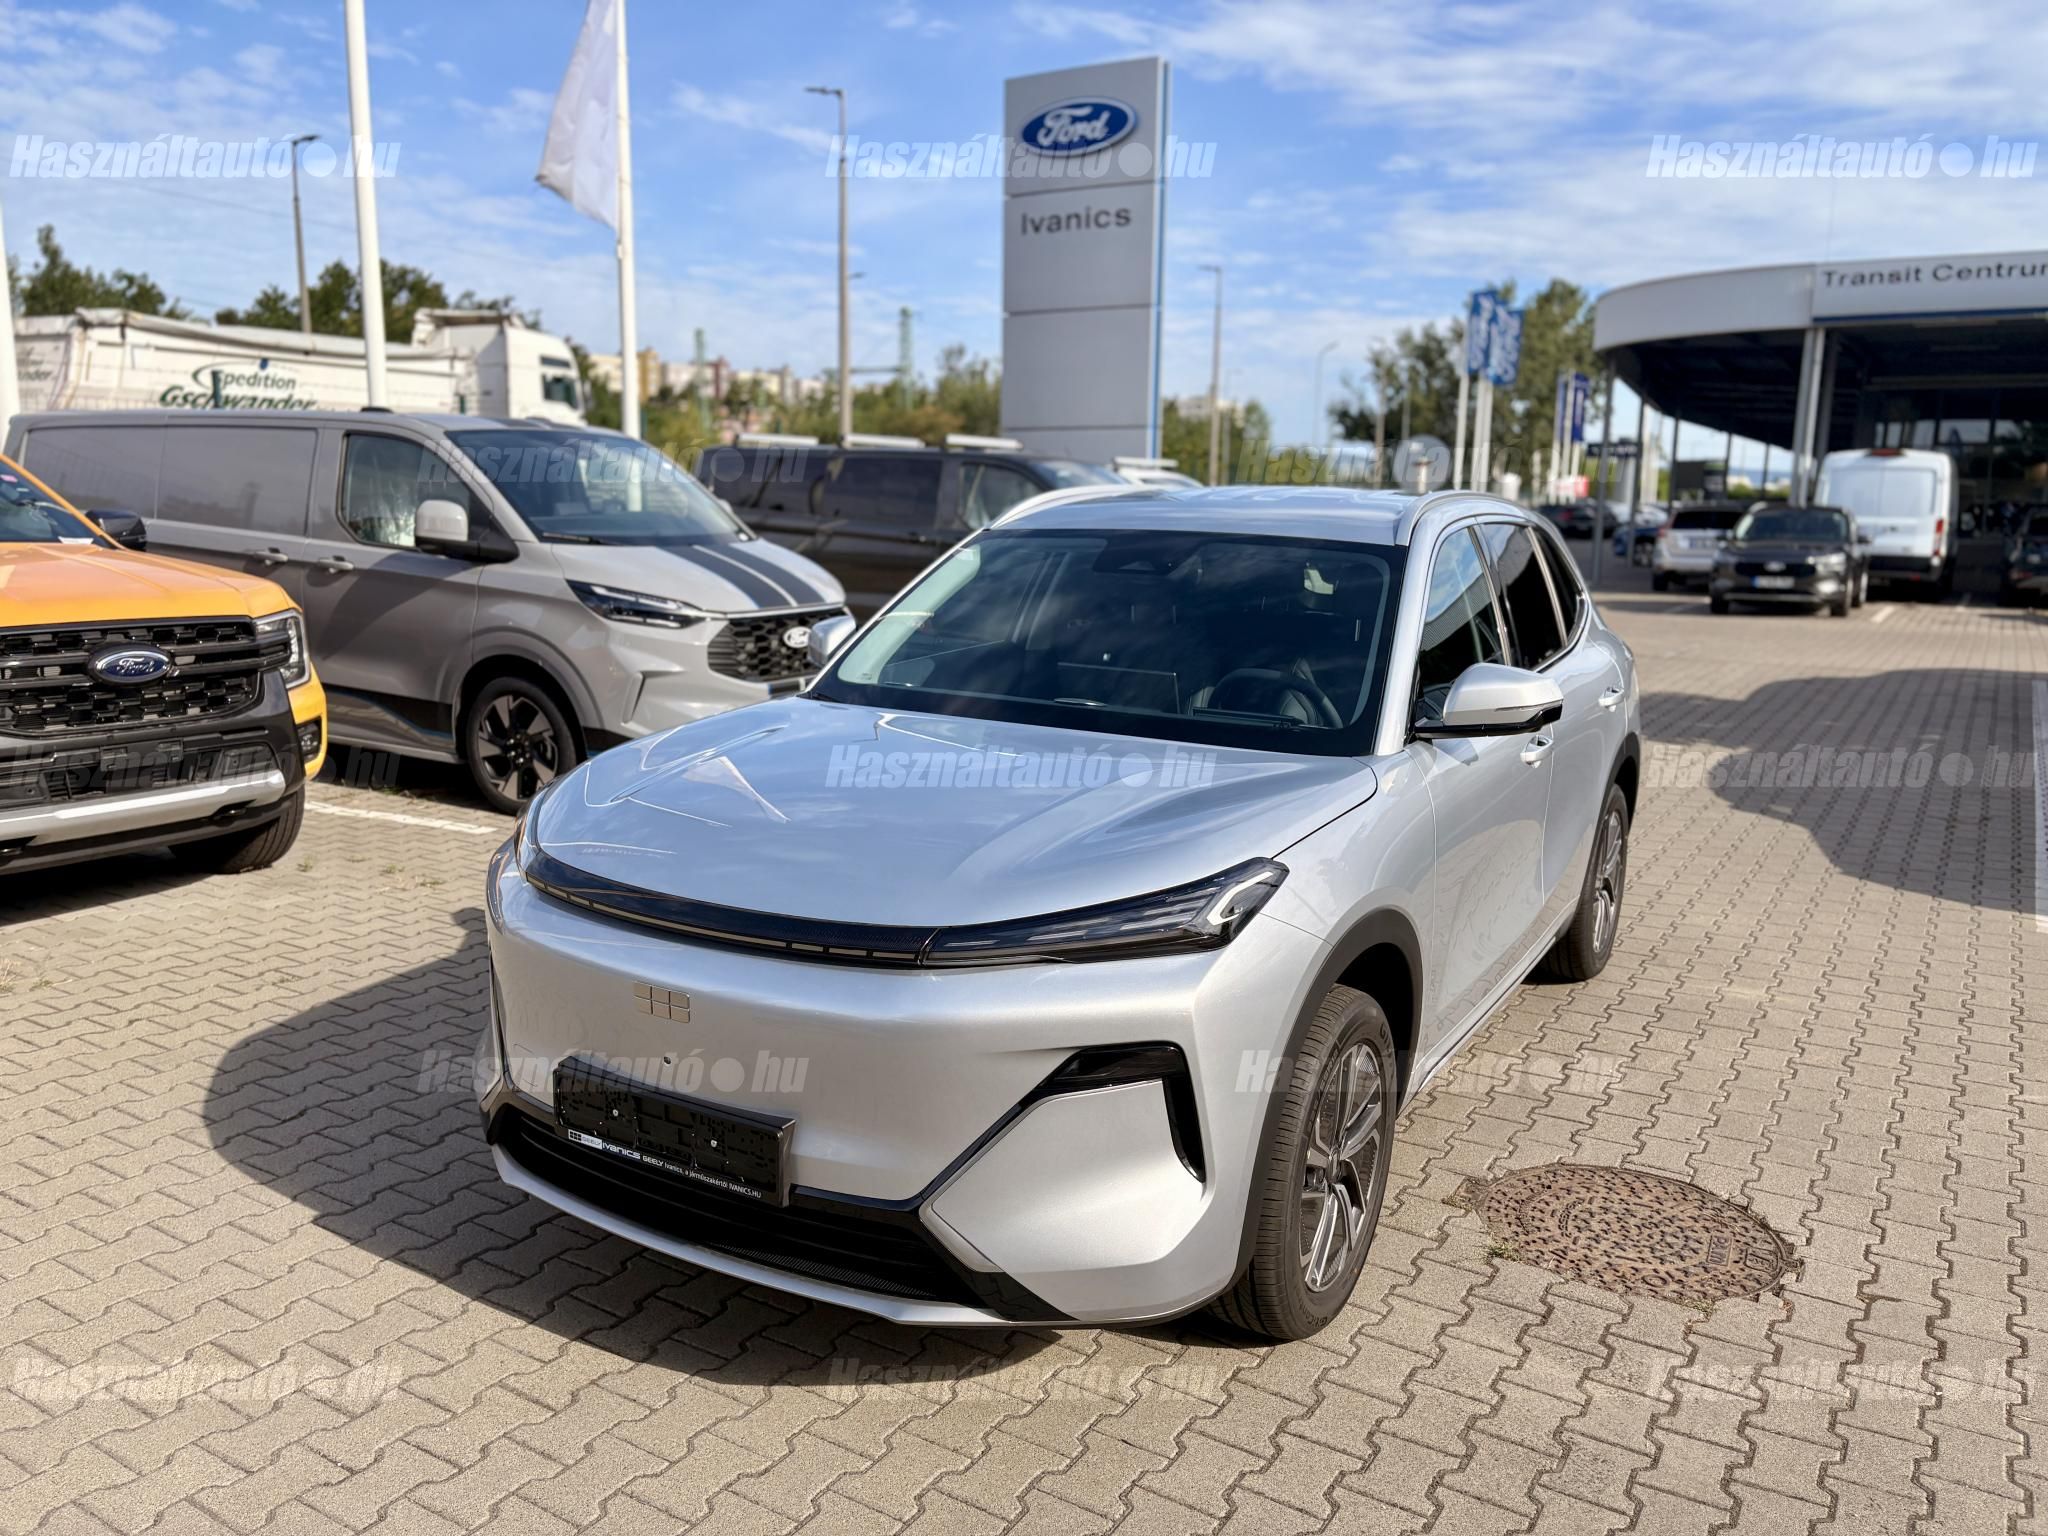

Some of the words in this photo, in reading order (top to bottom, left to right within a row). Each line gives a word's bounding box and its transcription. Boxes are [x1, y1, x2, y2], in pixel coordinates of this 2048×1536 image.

[1036, 105, 1111, 147] Ford
[1020, 206, 1132, 235] Ivanics
[1823, 265, 1922, 288] Transit
[211, 370, 297, 390] pedition
[116, 657, 155, 674] Ford
[642, 1155, 664, 1167] GEELY
[729, 1182, 762, 1198] IVANICS.HU
